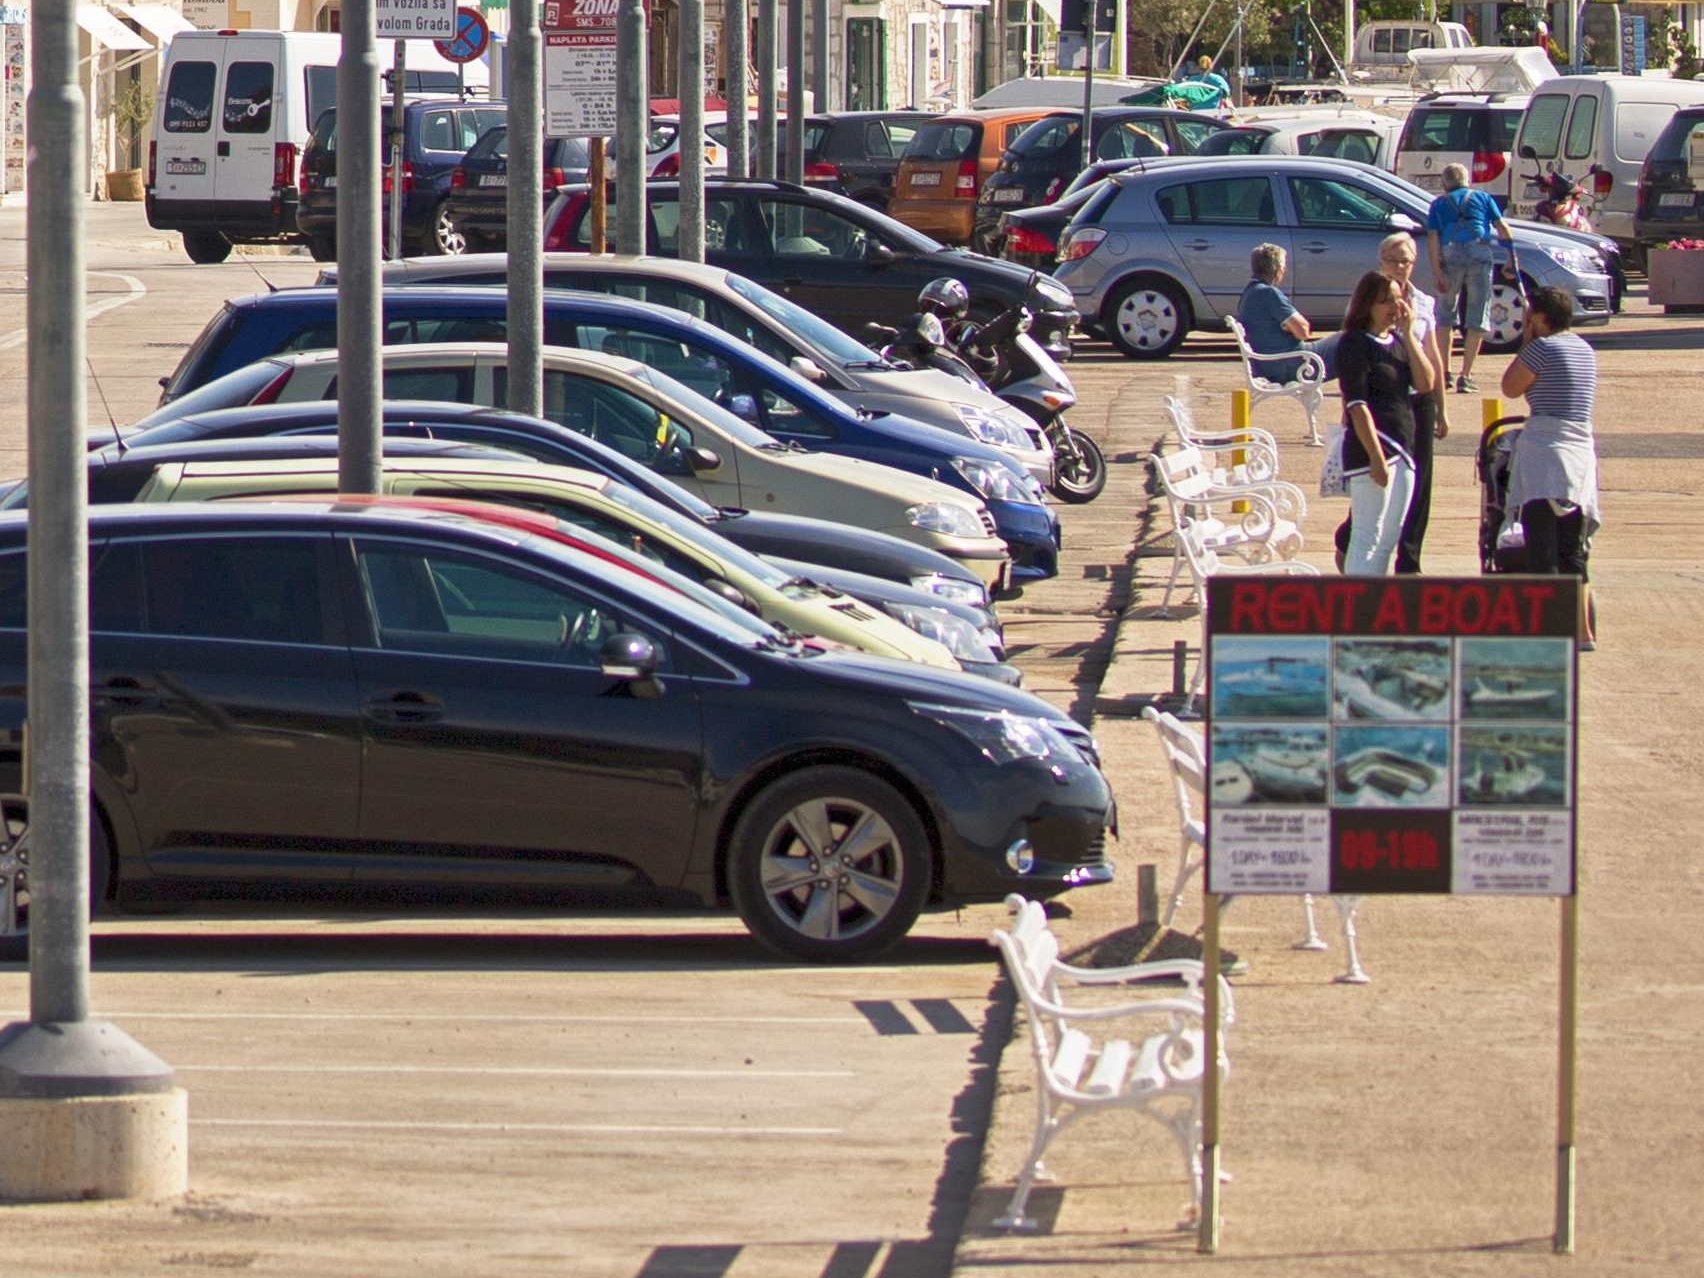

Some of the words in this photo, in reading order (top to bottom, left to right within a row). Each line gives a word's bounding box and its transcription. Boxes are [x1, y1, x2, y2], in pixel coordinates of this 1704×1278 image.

[377, 16, 412, 30] volom
[416, 16, 451, 31] Grada
[549, 36, 587, 44] NAPLATA
[1230, 583, 1367, 632] RENT
[1372, 583, 1408, 633] A
[1419, 583, 1555, 634] BOAT
